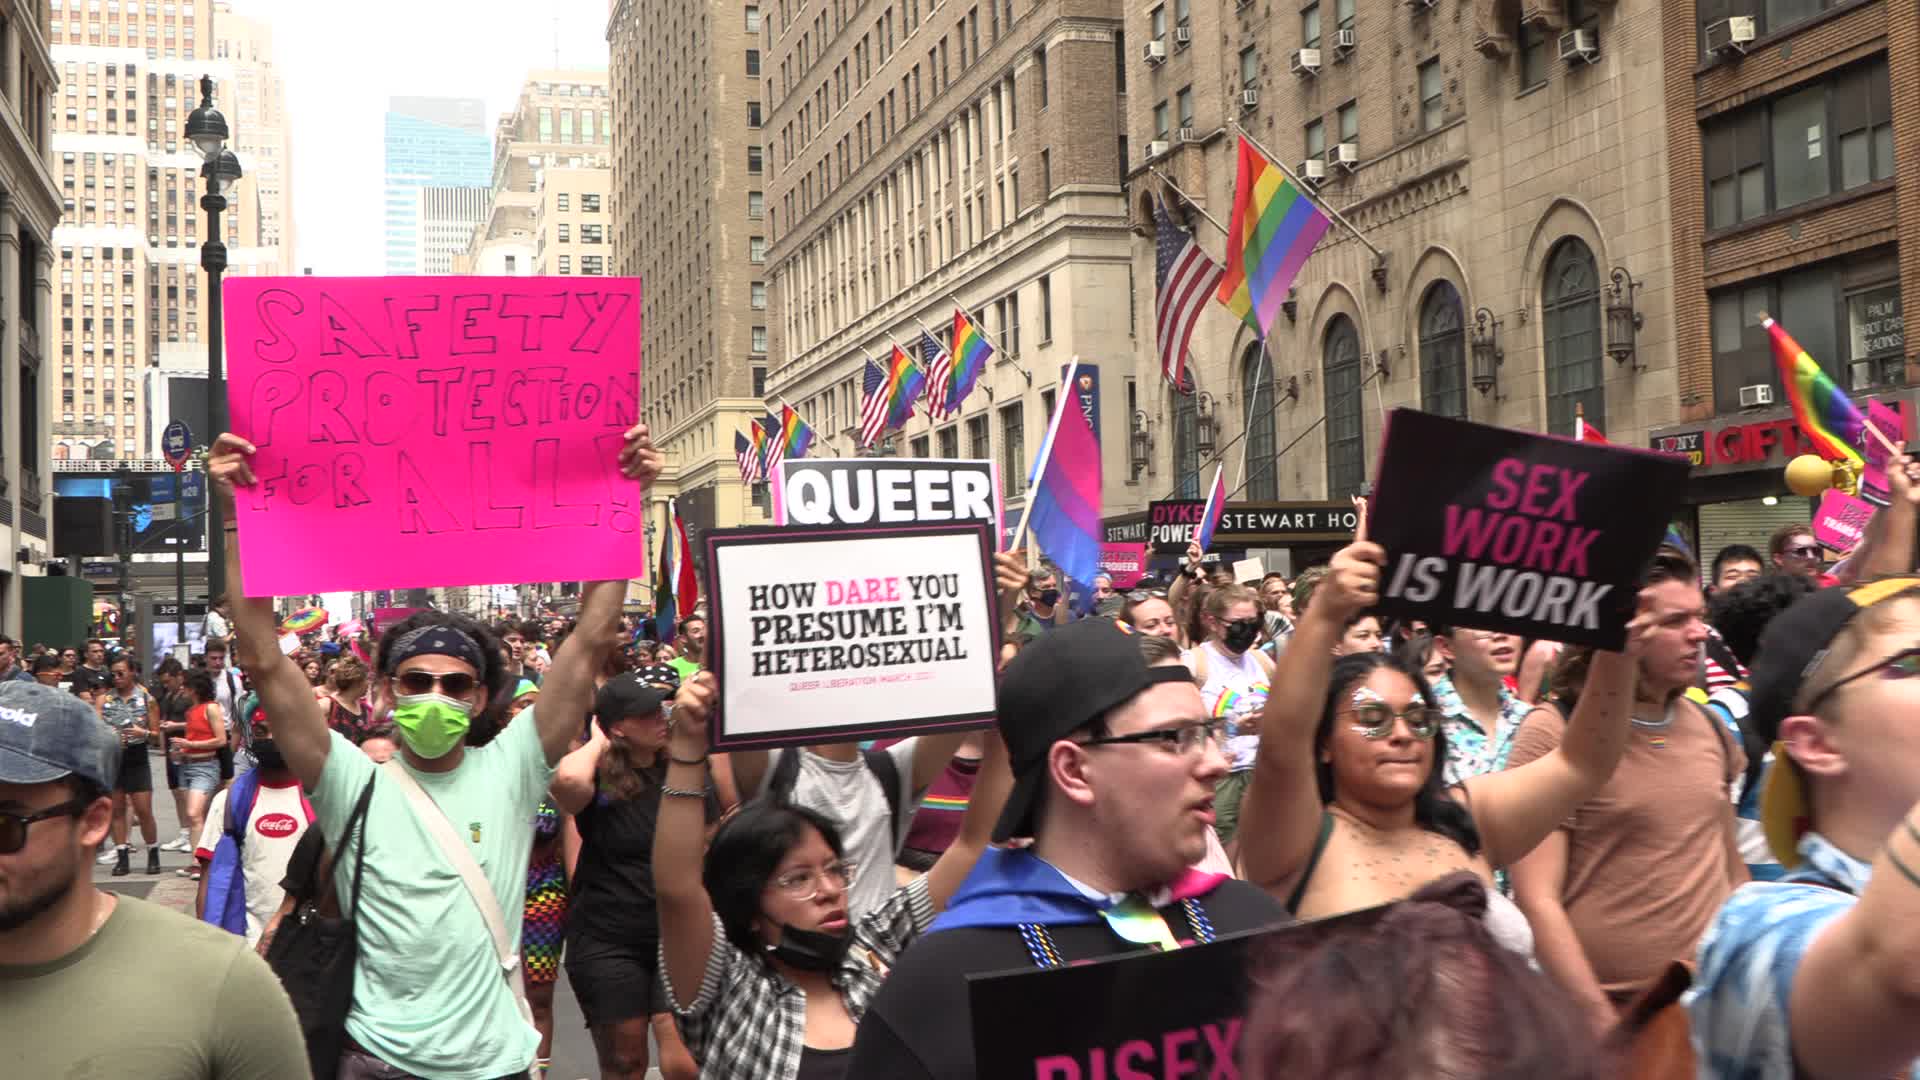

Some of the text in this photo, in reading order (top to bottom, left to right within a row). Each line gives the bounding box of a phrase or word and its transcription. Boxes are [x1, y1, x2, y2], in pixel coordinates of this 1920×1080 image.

[255, 289, 632, 364] SAFETY
[251, 452, 371, 511] FOR
[786, 468, 994, 525] QUEER
[1487, 457, 1591, 522] SEX
[1107, 523, 1146, 542] STEWART
[1150, 523, 1201, 543] POWE
[1153, 503, 1206, 524] DYKE
[1222, 513, 1317, 529] STEWART
[1443, 503, 1604, 577] WORK
[749, 573, 959, 611] HOW DARE YOU
[1385, 552, 1615, 631] IS WORK
[751, 605, 907, 646] PRESUME
[752, 636, 968, 677] HETEROSEXUAL
